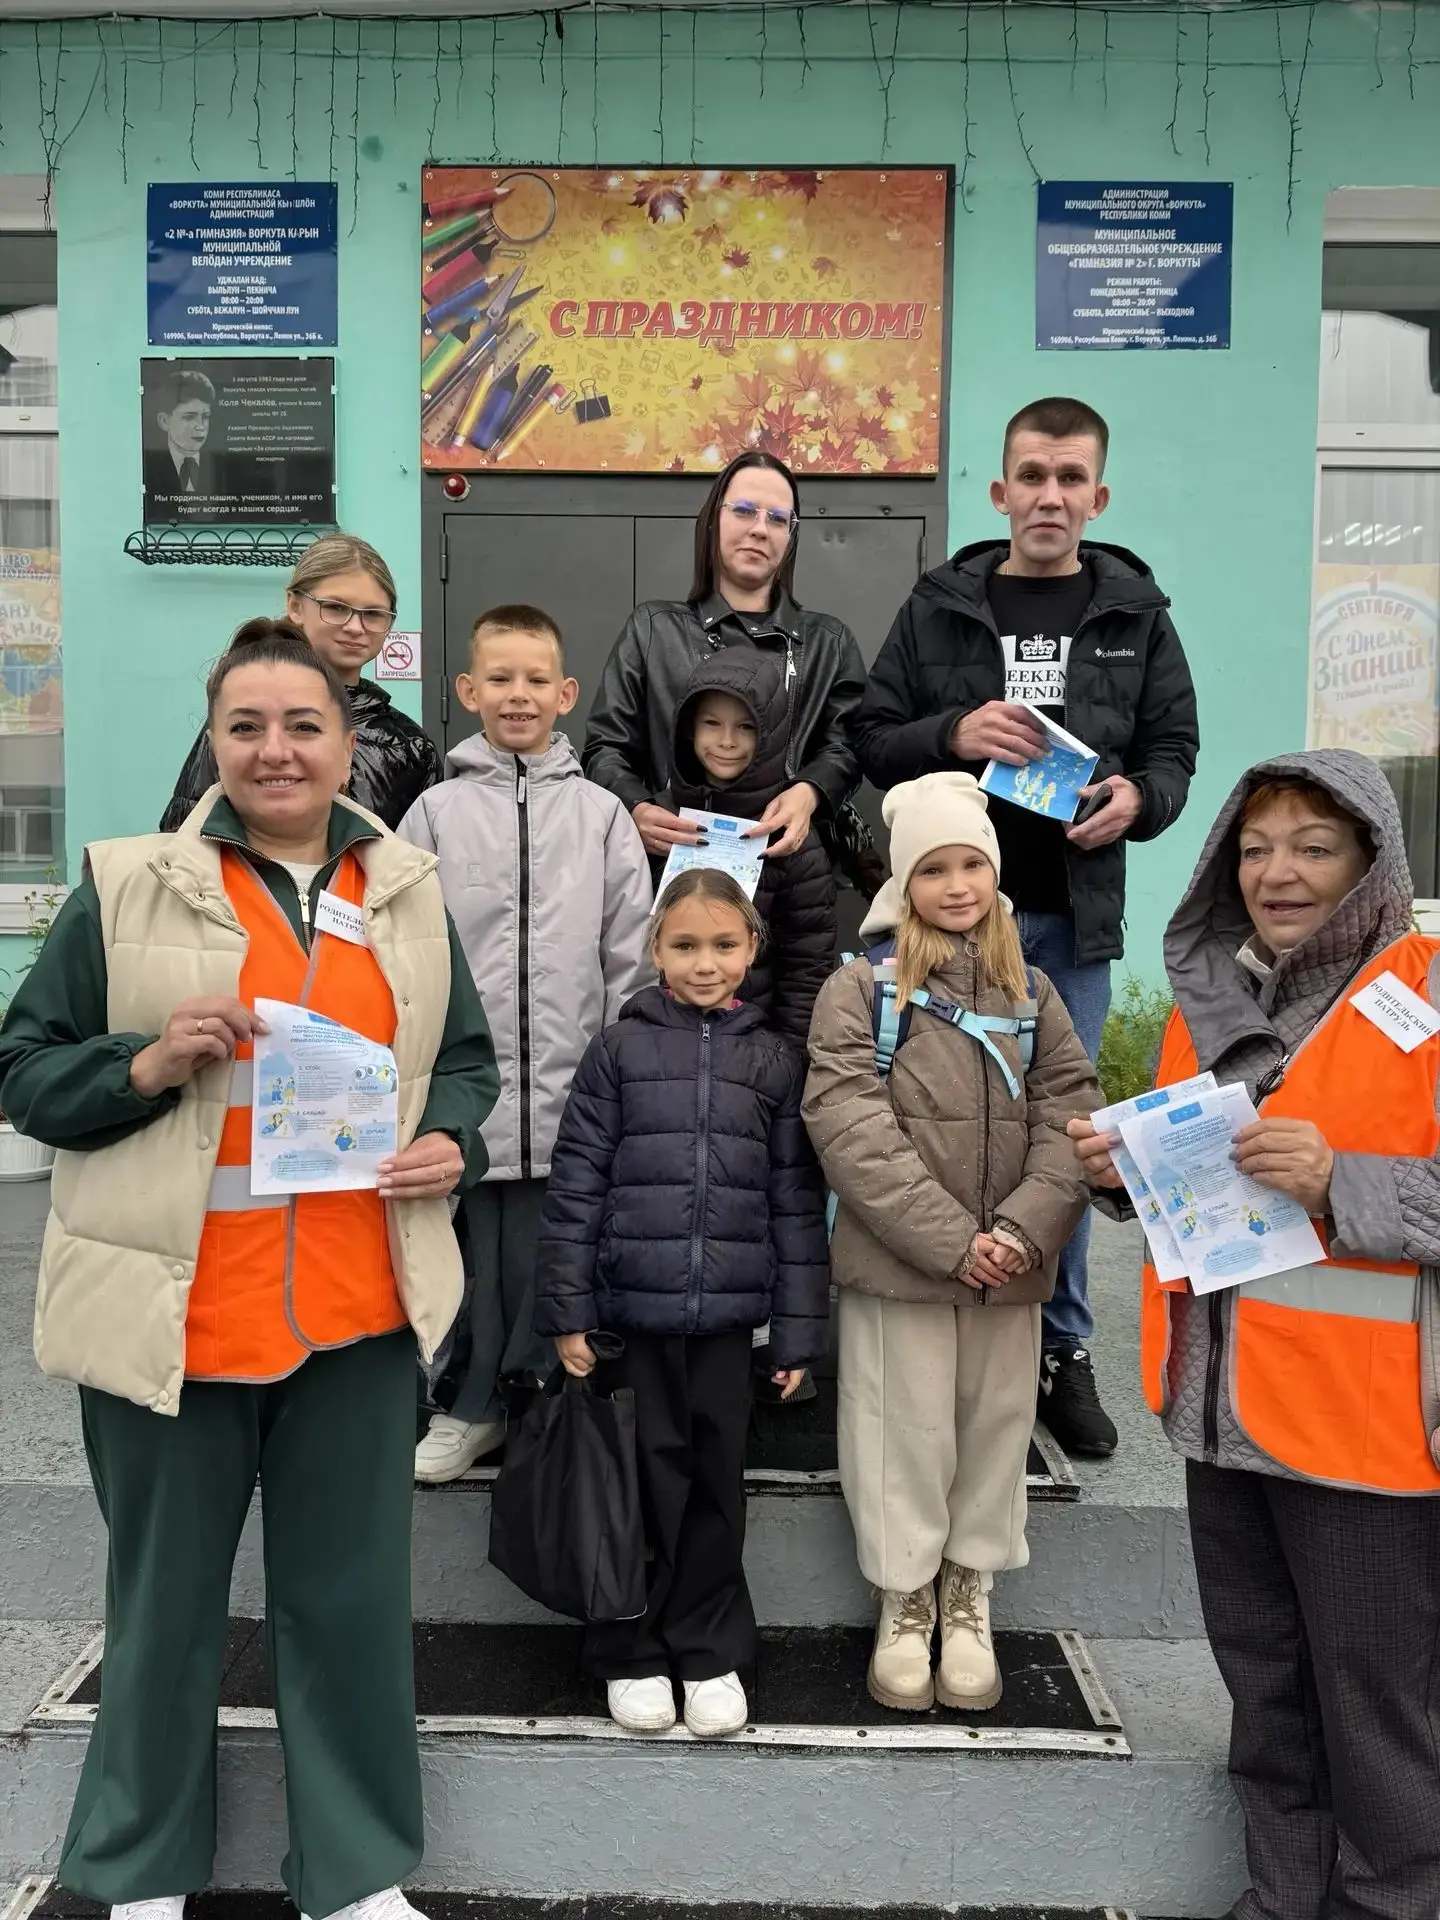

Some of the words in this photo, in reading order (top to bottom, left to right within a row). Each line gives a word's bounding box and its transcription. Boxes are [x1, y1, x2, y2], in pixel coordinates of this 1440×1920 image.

[203, 189, 225, 199] КОМИ
[226, 189, 281, 199] РЕСПУБЛИКАСА
[1102, 189, 1169, 200] АДМИНИСТРАЦИЯ
[169, 200, 208, 209] «ВОРКУТА»
[1065, 199, 1136, 210] МУНИЦИПАЛЬНОГО
[1137, 199, 1164, 209] ОКРУГА
[1166, 200, 1206, 209] «ВОРКУТА»
[210, 209, 274, 219] АДМИНИСТРАЦИЯ
[1100, 210, 1148, 220] РЕСПУБЛИКИ
[1149, 210, 1171, 219] КОМИ
[165, 228, 175, 239] «2
[196, 228, 247, 239] ГИМНАЗИЯ»
[249, 227, 286, 239] ВОРКУТА
[1094, 229, 1176, 242] МУНИЦИПАЛЬНОЕ
[1047, 243, 1160, 256] ОБЩЕОБРАЗОВАТЕЛЬНОЕ
[1160, 243, 1223, 255] УЧРЕЖДЕНИЕ
[234, 255, 293, 267] УЧРЕЖДЕНИЕ
[1068, 257, 1123, 269] «ГИМНАЗИЯ
[1124, 257, 1135, 268] №
[1135, 257, 1147, 268] 2»
[1148, 258, 1156, 268] Г.
[1157, 257, 1201, 268] ВОРКУТЫ
[217, 276, 250, 285] УДЖАЛАН
[251, 276, 267, 285] КАД:
[1106, 277, 1132, 286] РЕЖИМ
[1132, 277, 1162, 286] РАБОТЫ:
[207, 286, 240, 295] ВЫЛЬЛУН
[246, 286, 277, 295] ПЕКНИЧА
[1090, 287, 1140, 297] ПОНЕДЕЛЬНИК
[1146, 287, 1178, 297] ПЯТНИЦА
[220, 296, 239, 305] 08:00
[245, 296, 264, 305] 20:00
[1111, 298, 1131, 307] 08:00
[1137, 298, 1156, 307] 20:00
[214, 306, 245, 315] ВЕЖАЛУН
[286, 306, 299, 315] ЛУН
[1073, 307, 1104, 318] СУББОТА,
[1105, 307, 1150, 317] ВОСКРЕСЕНЬЕ
[1156, 306, 1195, 317] ВЫХОДНОЙ
[550, 300, 581, 338] С
[583, 300, 929, 348] ПРАЗДНИКОМ!
[240, 333, 265, 341] Воркута
[219, 399, 239, 408] Коля
[154, 494, 168, 502] Мы
[169, 494, 208, 503] гордимся
[209, 494, 240, 502] нашим,
[241, 494, 283, 503] учеником,
[177, 505, 201, 514] будет
[202, 506, 230, 514] всегда
[1365, 571, 1379, 596] 1
[1337, 598, 1416, 622] СЕНТЯБРЯ
[1328, 634, 1342, 661] С
[1346, 628, 1405, 656] Днем
[1314, 635, 1436, 692] Знаний!
[1006, 670, 1067, 683] EEKEN
[1005, 685, 1066, 699] FEND
[319, 903, 364, 926] РОДИТЕЛЬ
[332, 917, 366, 936] ПАТРУЛ
[1370, 982, 1434, 1036] РОДИТЕЛЬСКИЙ
[1374, 998, 1411, 1032] ПАТРУЛЬ
